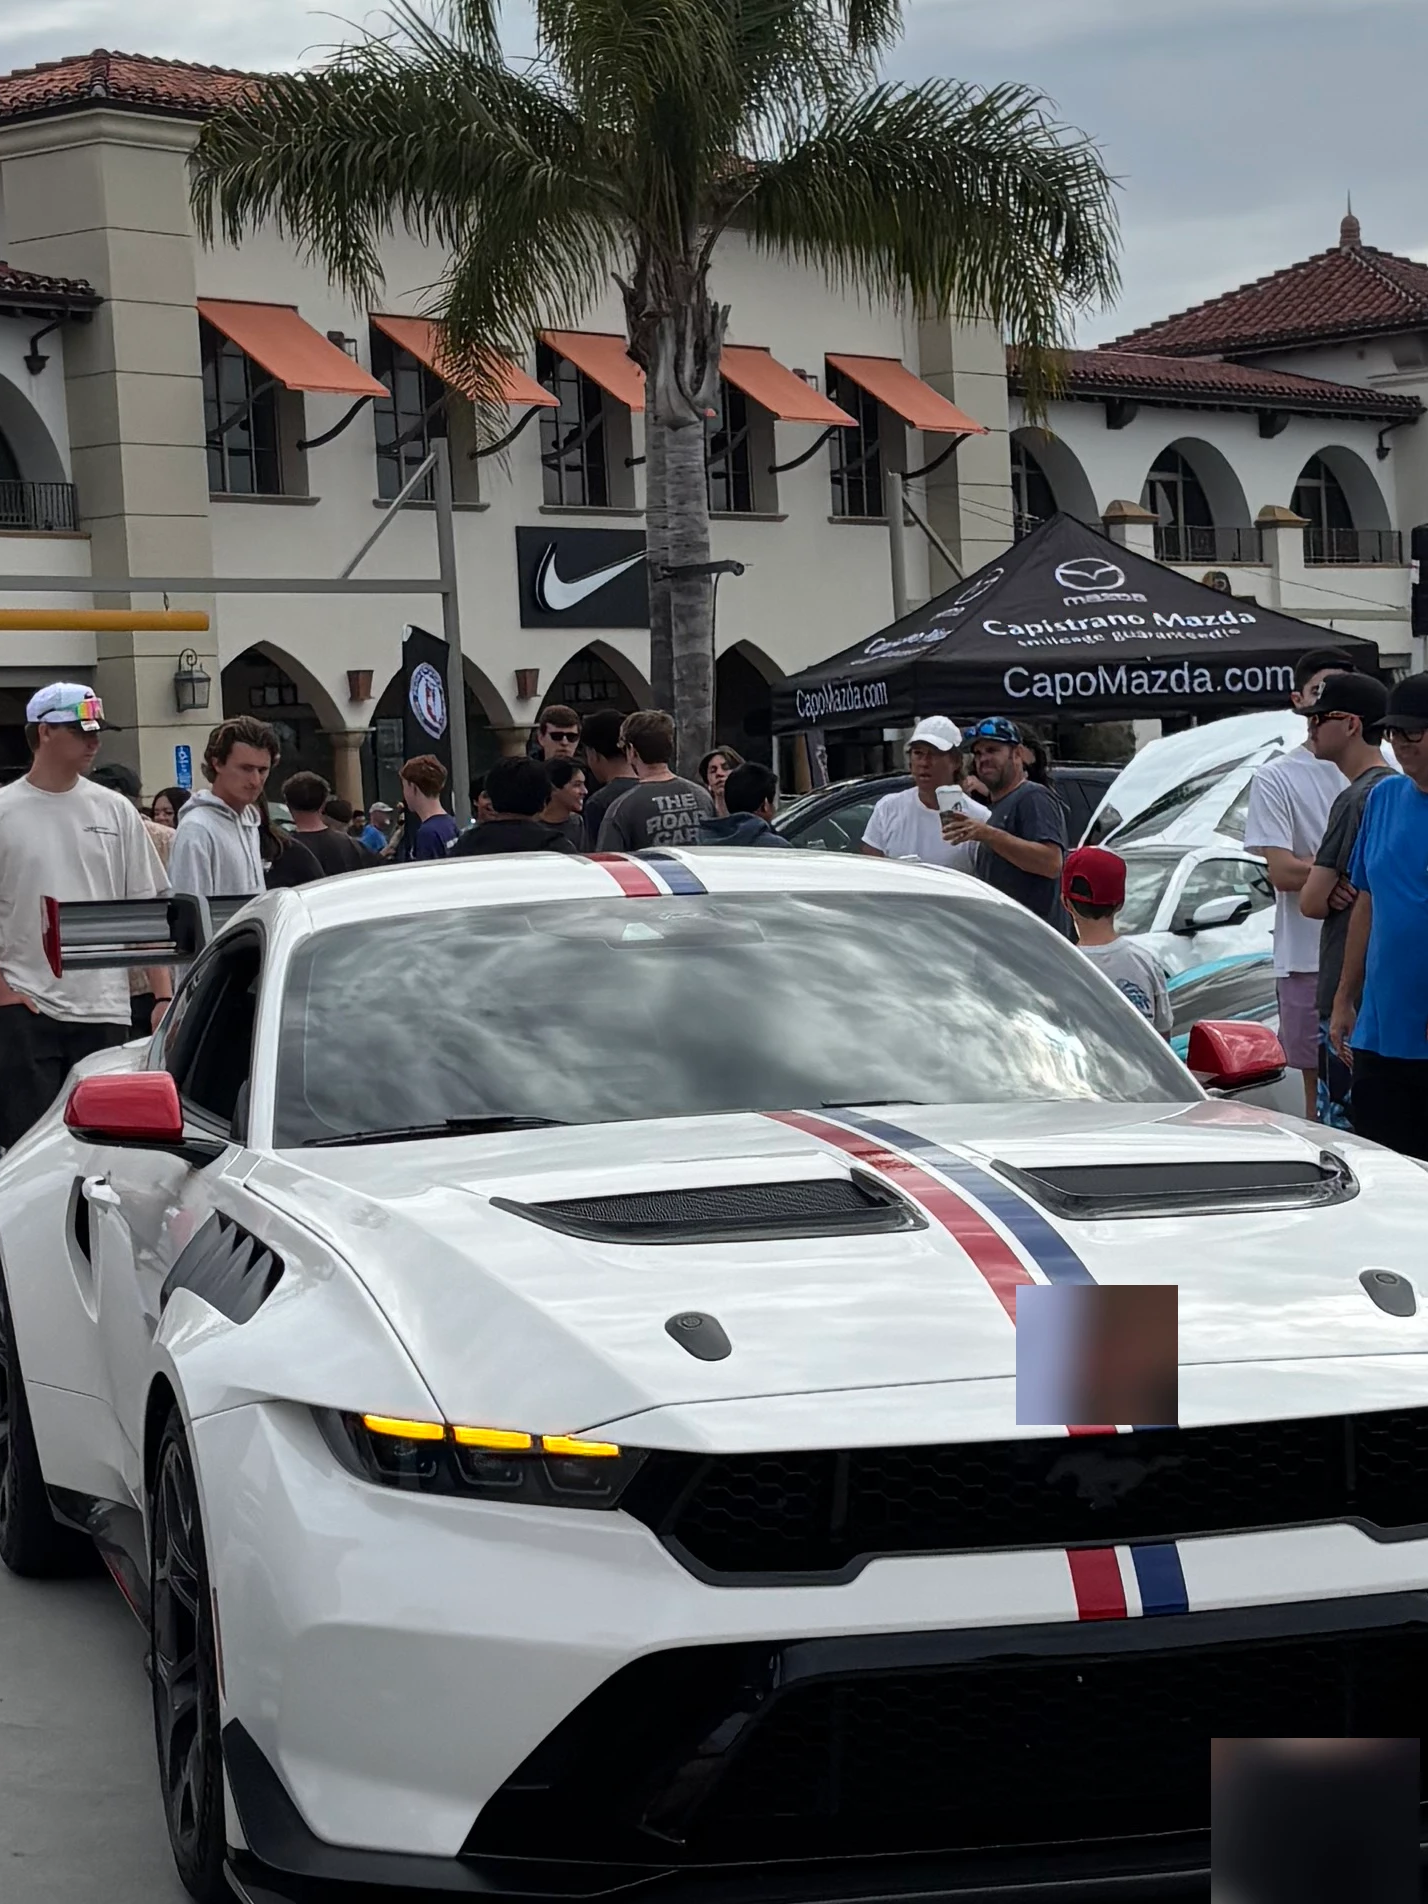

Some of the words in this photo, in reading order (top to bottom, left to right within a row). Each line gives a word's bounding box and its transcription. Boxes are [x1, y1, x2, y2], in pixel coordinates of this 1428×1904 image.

[983, 613, 1146, 638] Capistrano
[1153, 610, 1257, 628] Mazda
[796, 679, 888, 723] CapoMazda.com
[1003, 661, 1296, 705] CapoMazda.com
[652, 793, 698, 812] THE
